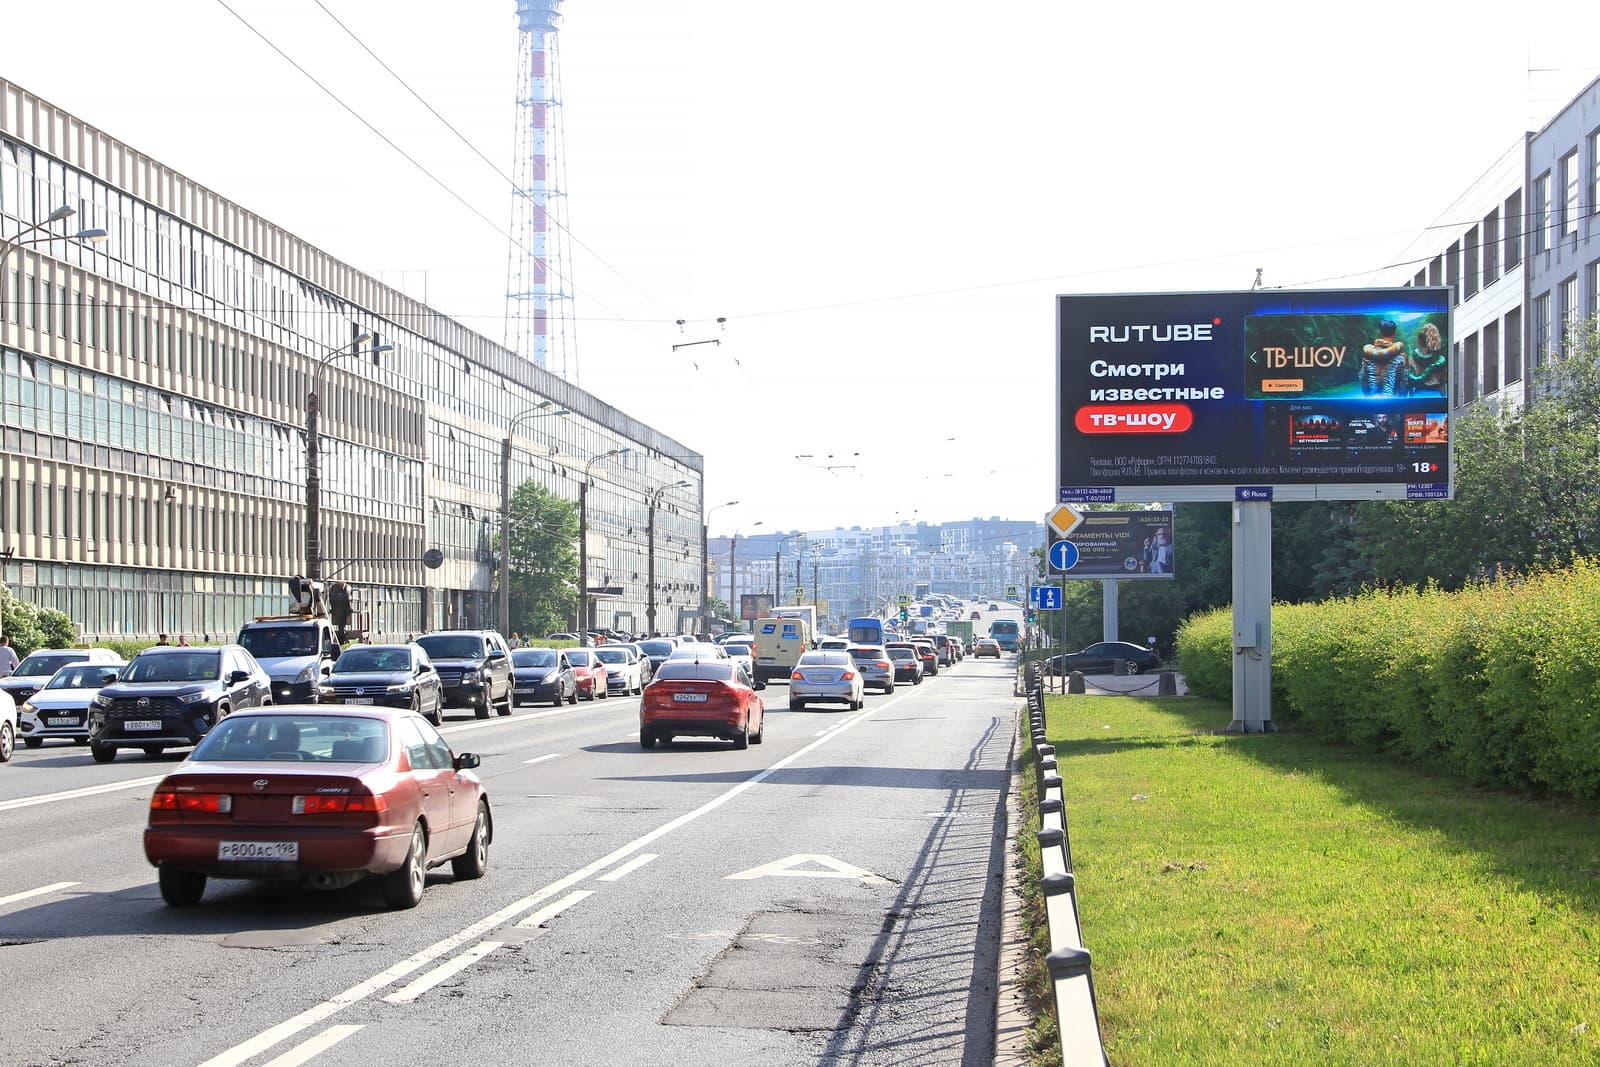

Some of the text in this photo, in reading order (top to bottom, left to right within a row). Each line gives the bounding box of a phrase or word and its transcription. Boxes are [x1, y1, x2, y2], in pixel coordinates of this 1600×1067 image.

[1090, 324, 1213, 343] RUTUBE
[1262, 346, 1346, 368] ТВ-ШОУ
[1090, 360, 1185, 380] Смотри
[1090, 386, 1225, 402] известные
[1090, 412, 1176, 430] тв-шоу
